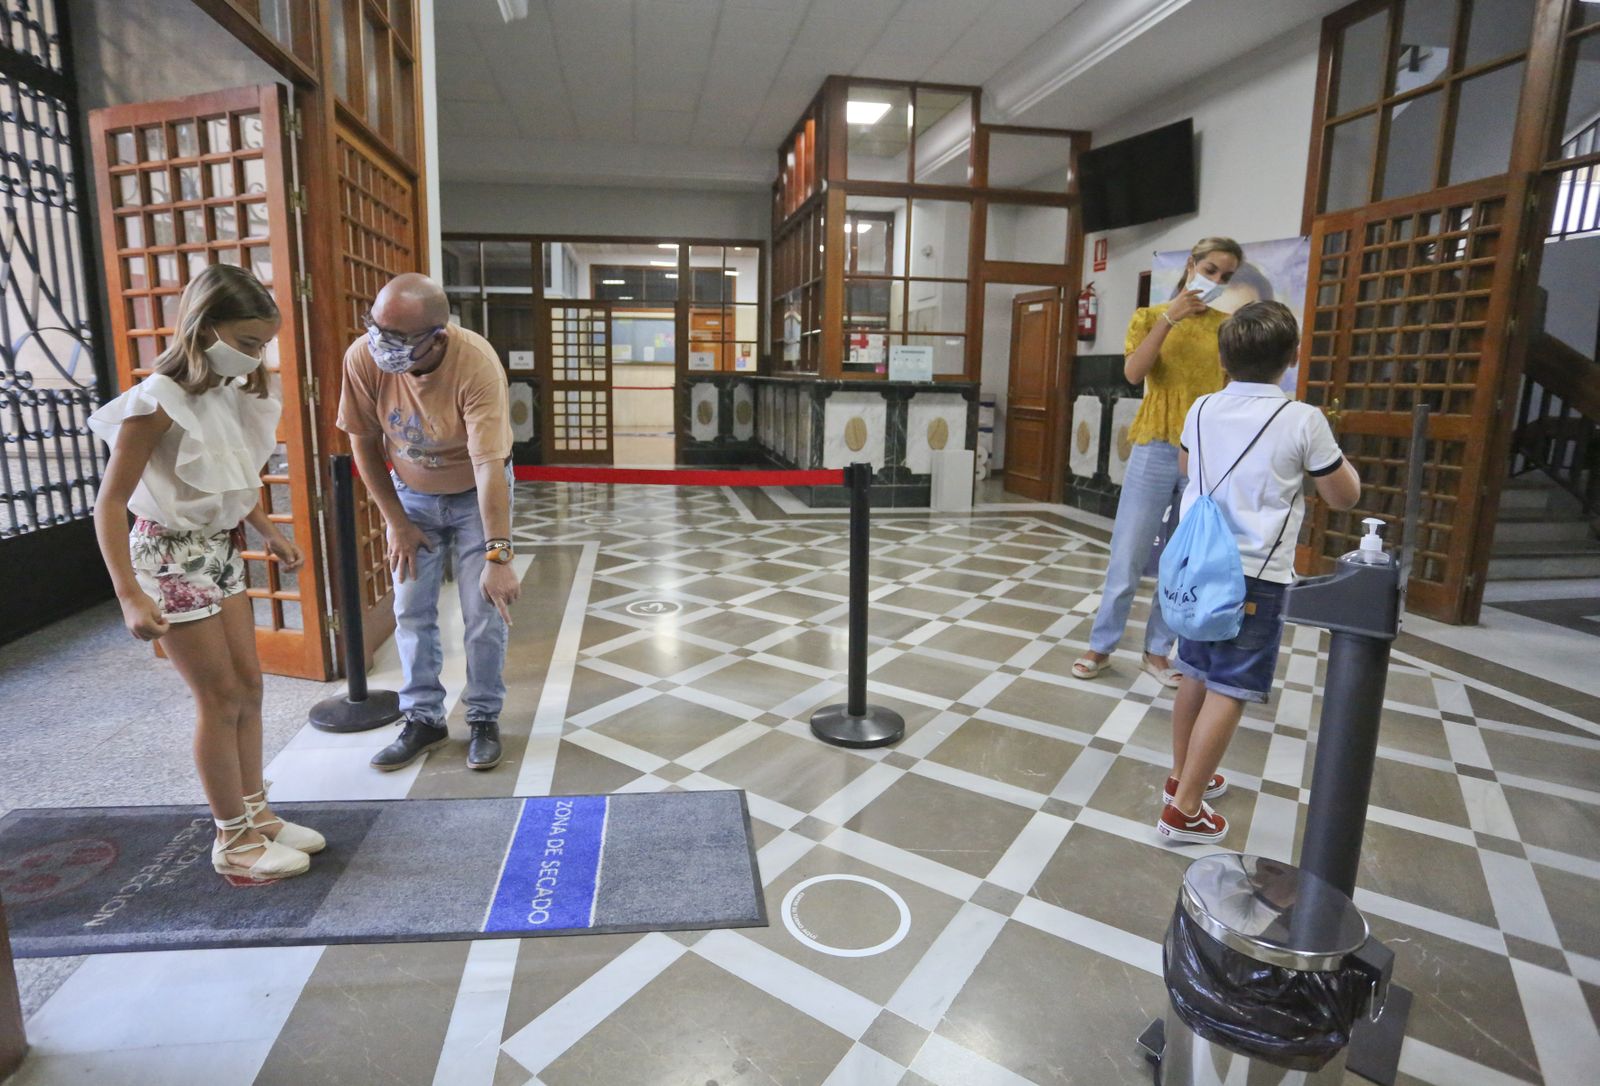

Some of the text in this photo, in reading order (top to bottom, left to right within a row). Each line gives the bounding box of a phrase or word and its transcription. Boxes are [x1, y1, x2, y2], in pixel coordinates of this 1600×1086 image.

[83, 818, 211, 927] DESINFECCION
[151, 844, 209, 887] ZONA
[528, 800, 574, 925] ZONA DE SECADO
